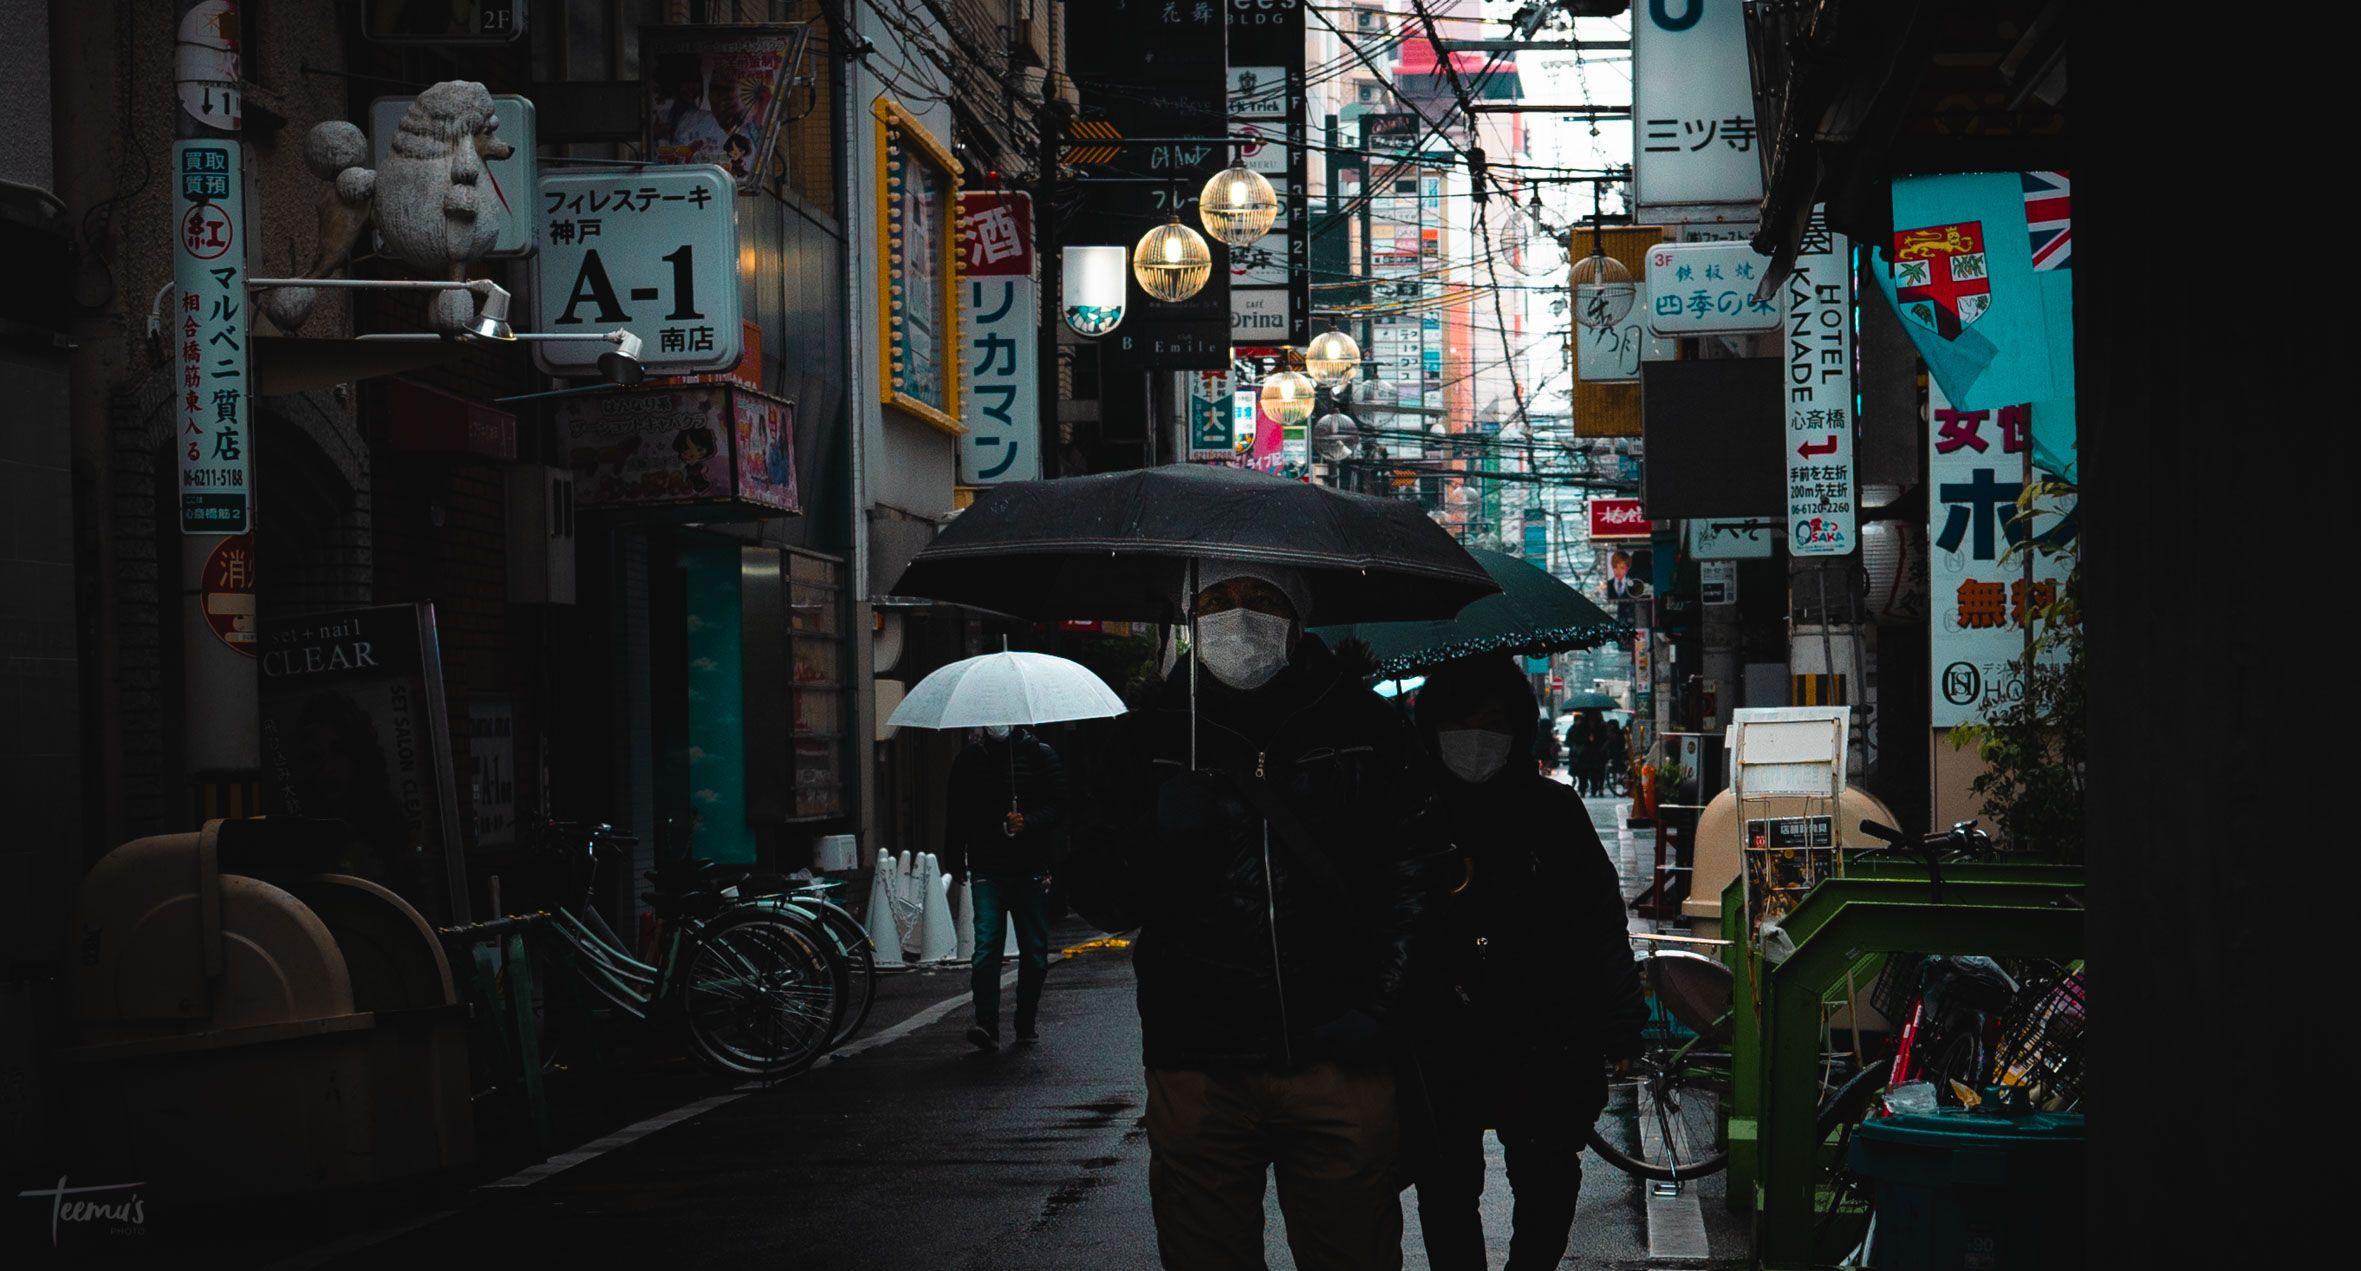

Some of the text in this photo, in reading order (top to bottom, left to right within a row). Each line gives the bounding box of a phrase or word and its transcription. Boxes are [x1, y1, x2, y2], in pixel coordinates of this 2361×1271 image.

[483, 9, 510, 29] 2F
[1645, 115, 1756, 152] 三ツ寺
[185, 152, 225, 170] 買取
[186, 176, 226, 194] 質預
[545, 185, 712, 214] フィレステーキ
[549, 219, 602, 245] 神戸
[963, 204, 1023, 267] 酒
[1654, 254, 1673, 267] 3F
[1675, 261, 1755, 282] 鉄板焼
[555, 245, 705, 324] A-1
[1656, 289, 1776, 319] 四季の味
[659, 325, 714, 352] 南店
[1122, 337, 1133, 351] B
[1155, 340, 1216, 353] Emile
[1790, 267, 1812, 403] KANADE
[1819, 285, 1843, 385] HOTEL
[182, 291, 203, 461] 相合橋筋東入る
[209, 267, 241, 461] マルベニ質店
[973, 281, 1018, 480] リカマン
[1791, 408, 1846, 431] 心斎橋
[183, 469, 243, 486] 06-6211-5188
[1790, 465, 1847, 482] 手前を左折
[1790, 483, 1847, 499] 200m先左折
[1791, 503, 1850, 515] 06-6120-2260
[319, 618, 361, 640] nail
[263, 641, 380, 677] CLEAR
[390, 685, 407, 713] SET
[395, 718, 414, 772] SALON
